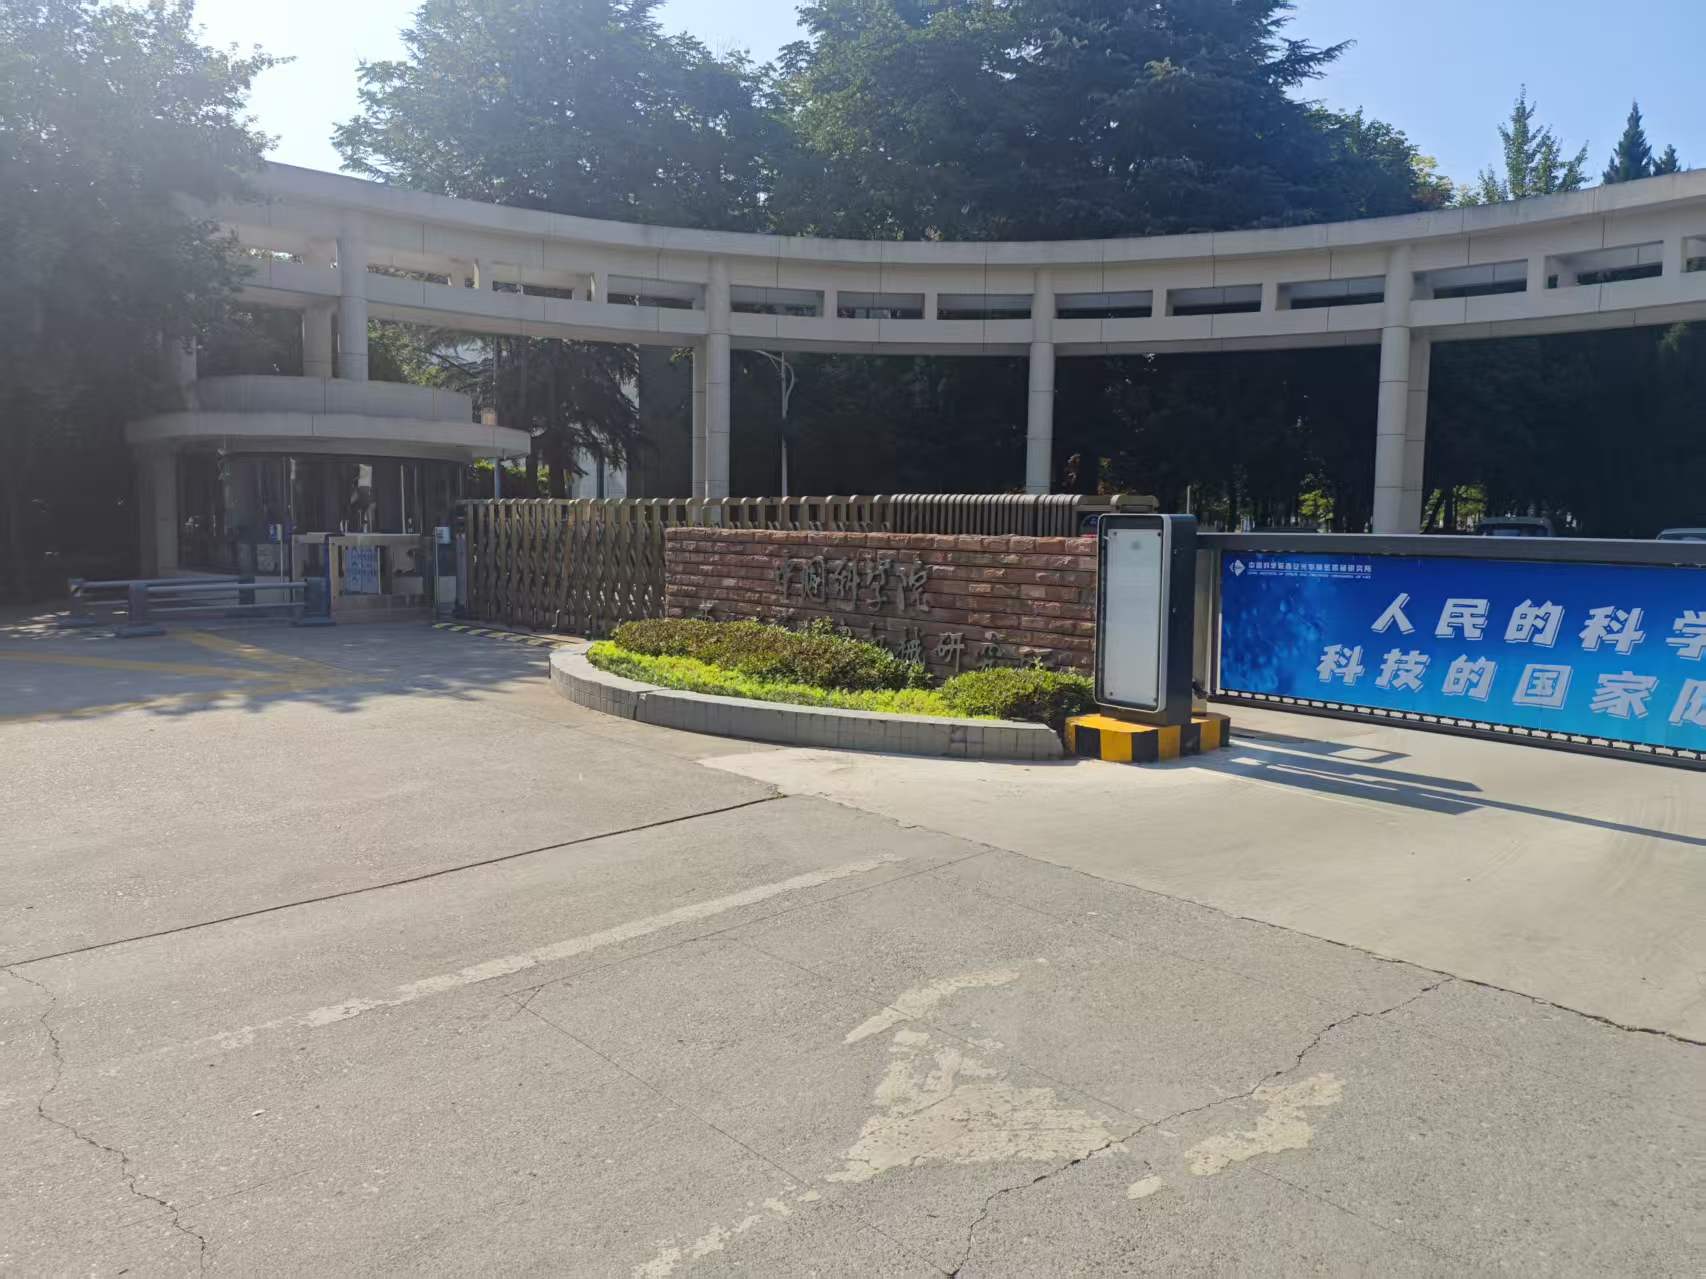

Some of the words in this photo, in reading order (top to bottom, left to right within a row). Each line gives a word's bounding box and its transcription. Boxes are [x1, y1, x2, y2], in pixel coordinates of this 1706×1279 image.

[1371, 593, 1706, 661] 人民的科学
